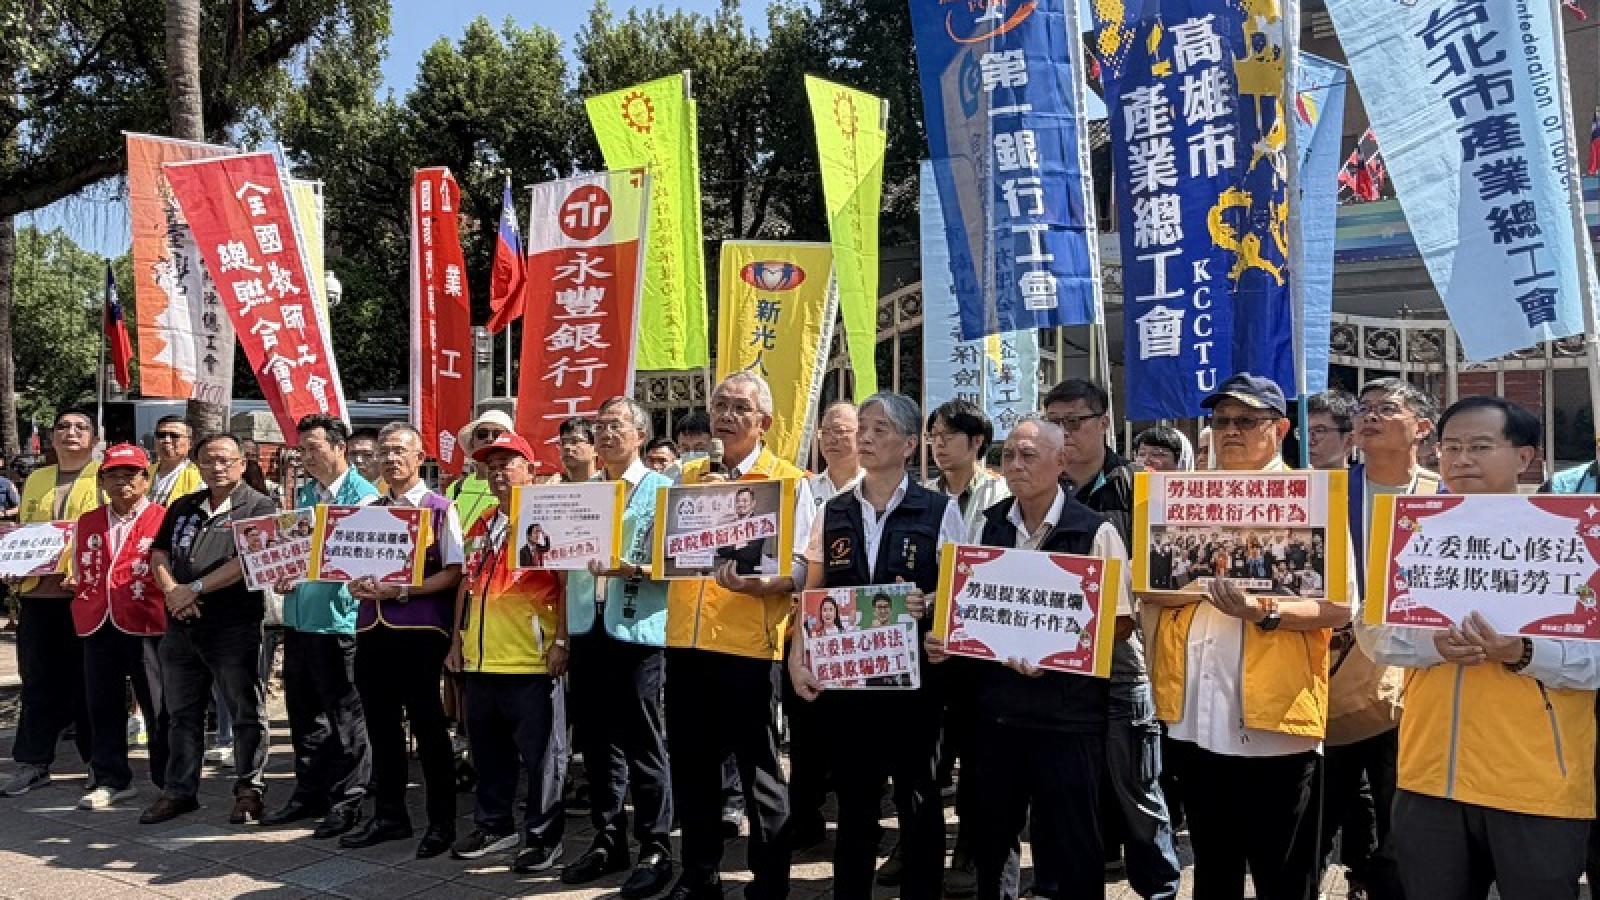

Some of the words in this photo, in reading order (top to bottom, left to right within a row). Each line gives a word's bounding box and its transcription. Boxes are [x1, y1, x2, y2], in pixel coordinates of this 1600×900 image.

[1168, 13, 1237, 179] 高雄市
[979, 49, 1058, 311] 第一銀行工會
[1120, 82, 1186, 361] 產業總工會
[236, 181, 330, 413] 全國教師工會
[217, 240, 295, 395] 總聯合會
[1192, 258, 1218, 393] KCCTU
[541, 250, 614, 445] 永豐銀行工
[1167, 479, 1308, 499] 勞退提案就擺爛
[1167, 503, 1308, 523] 政院敷衍不作為
[669, 516, 776, 556] 政院敷衍不作為
[1407, 535, 1585, 564] 立委無心修法
[965, 581, 1084, 611] 勞退提案就擺爛
[1405, 563, 1584, 596] 藍綠欺騙勞工
[962, 603, 1082, 634] 政院敷衍不作為
[815, 628, 906, 658] 立委無心修法
[816, 653, 908, 681] 藍綠欺騙勞工
